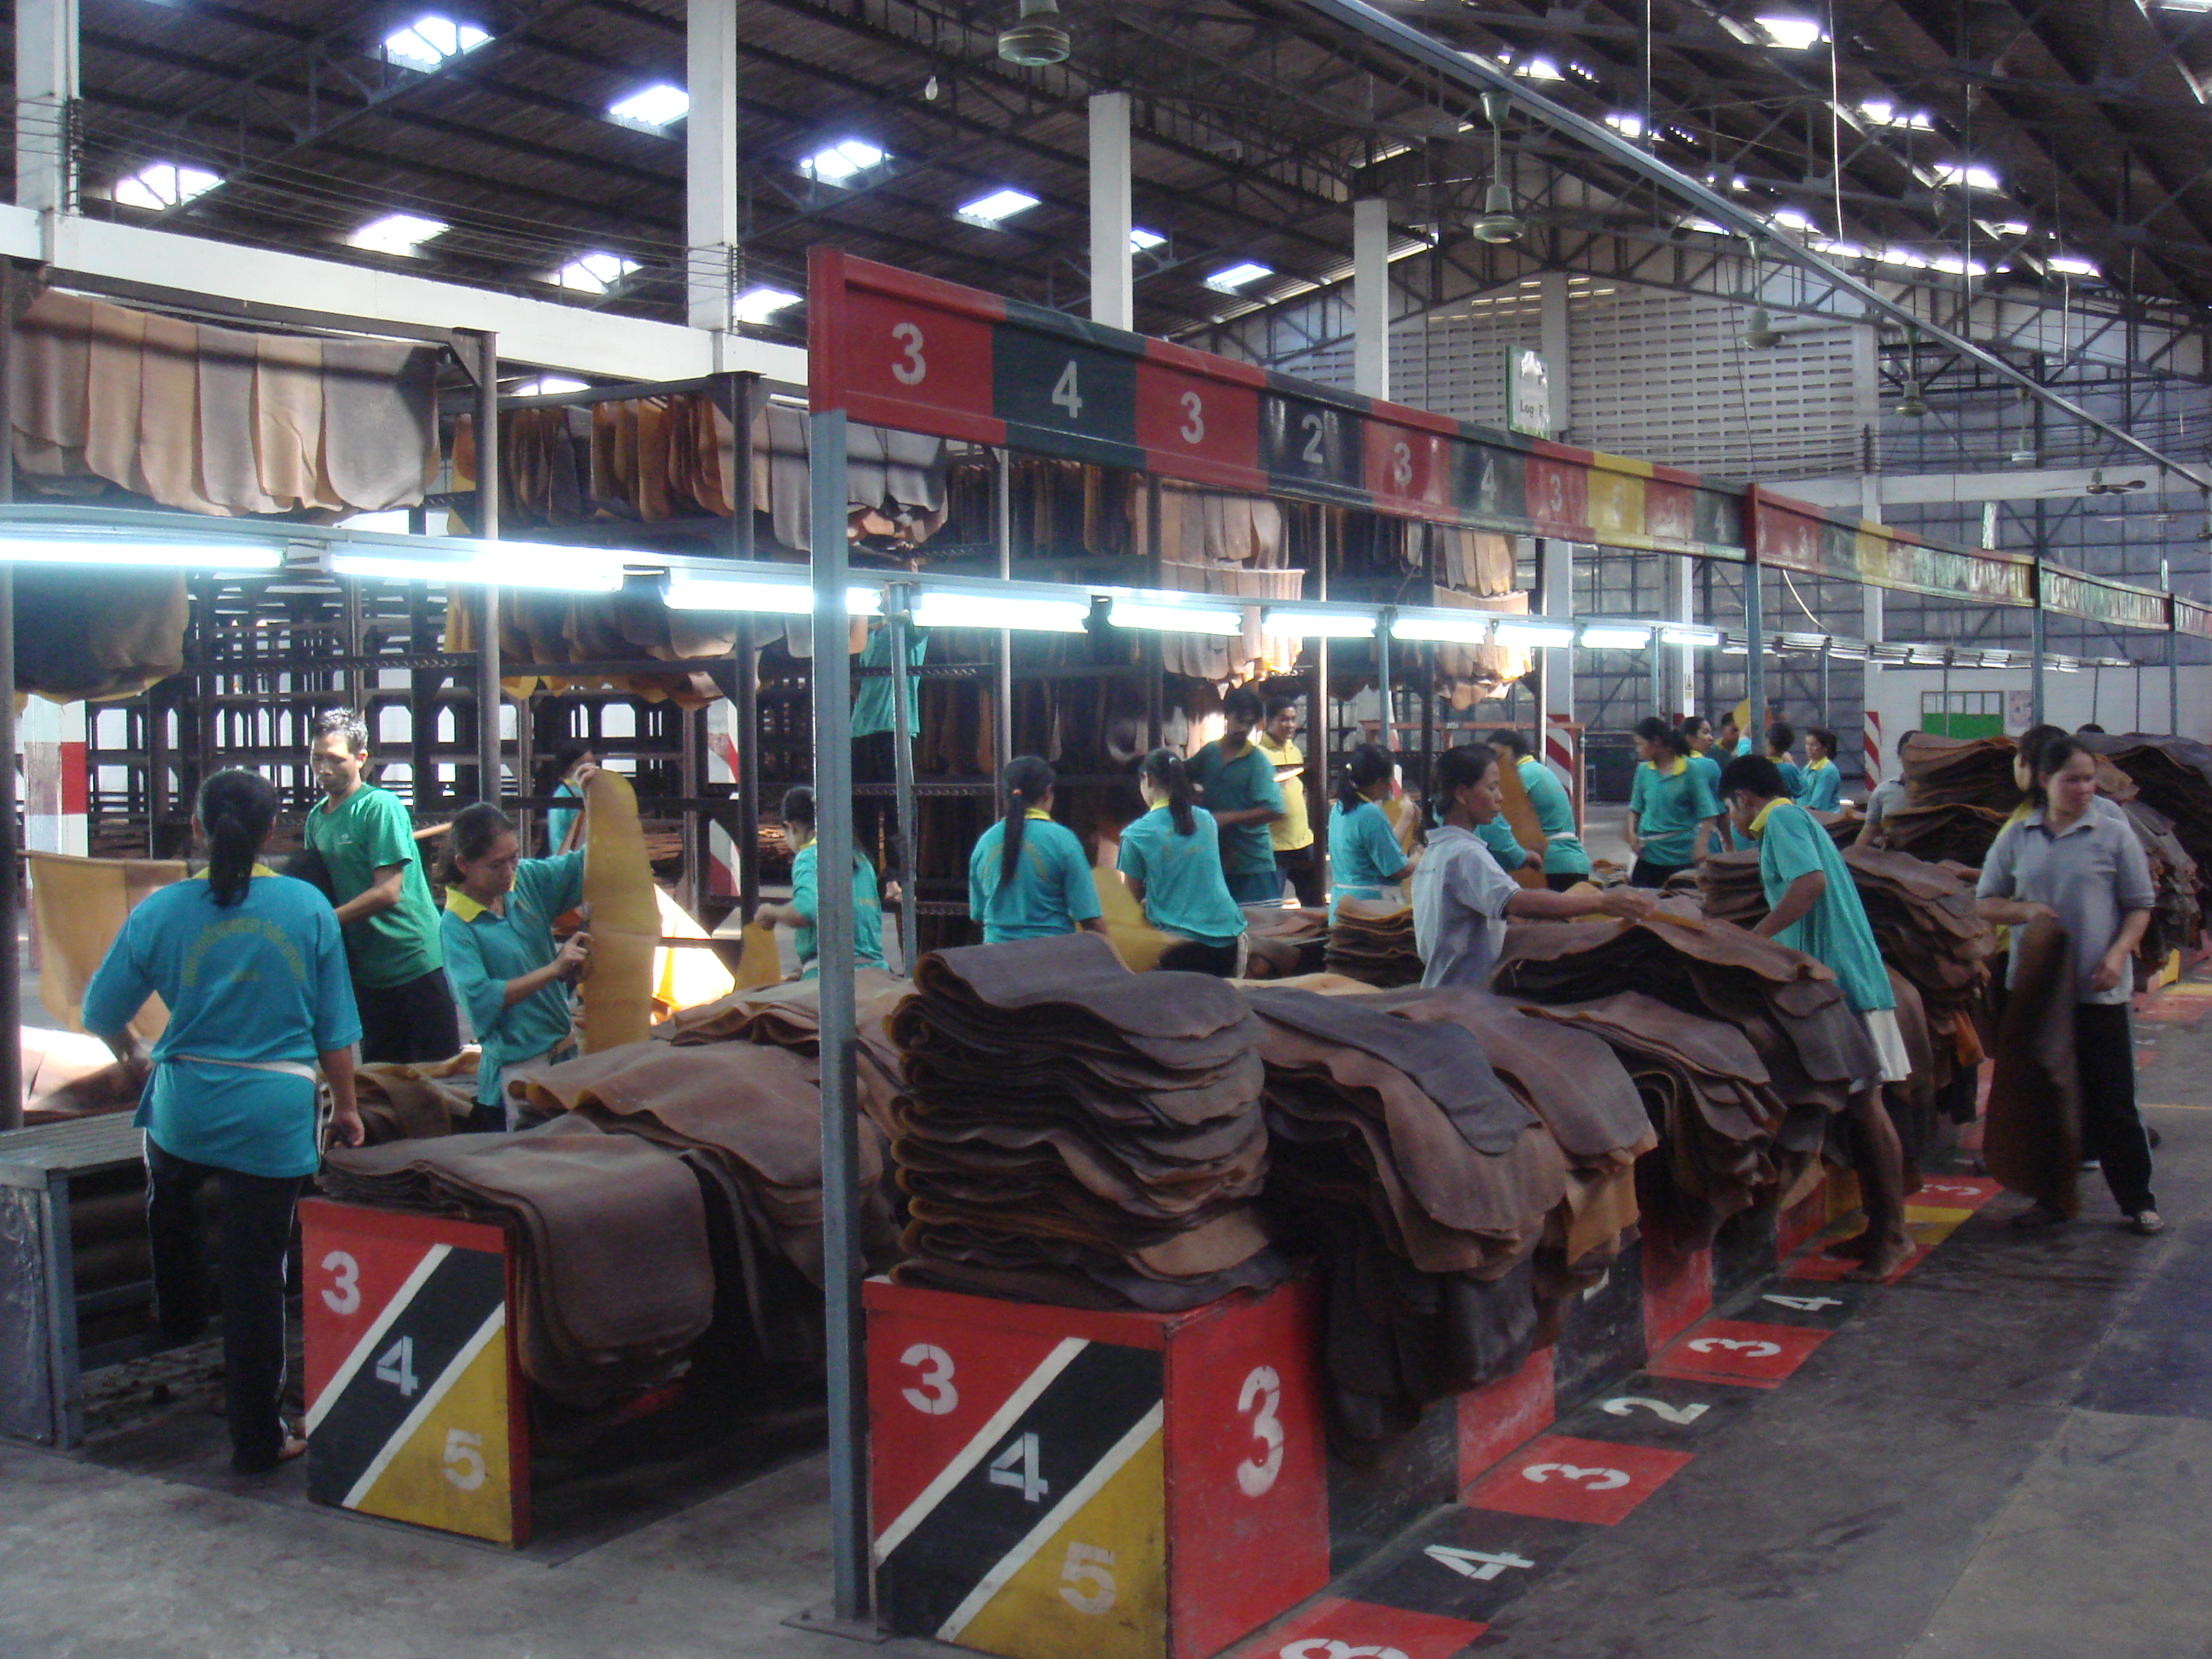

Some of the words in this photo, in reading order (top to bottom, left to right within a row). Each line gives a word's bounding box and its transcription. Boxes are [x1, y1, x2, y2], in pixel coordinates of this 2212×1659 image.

[891, 323, 927, 386] 3
[1051, 360, 1083, 419] 4
[1179, 391, 1205, 445] 3
[1301, 414, 1324, 464] 2
[1393, 440, 1413, 486] 3
[1481, 458, 1497, 503] 4
[1550, 474, 1563, 512] 3
[321, 1251, 361, 1315] 3
[1761, 1293, 1844, 1312] 4
[375, 1335, 418, 1396] 4
[1687, 1337, 1782, 1358] 3
[899, 1343, 959, 1416] 3
[1603, 1396, 1711, 1424] 2
[443, 1428, 486, 1491] 5
[1237, 1365, 1284, 1498] 3
[989, 1432, 1049, 1504] 4
[1522, 1463, 1632, 1491] 3
[1058, 1541, 1116, 1615] 5
[1423, 1544, 1536, 1581] 4
